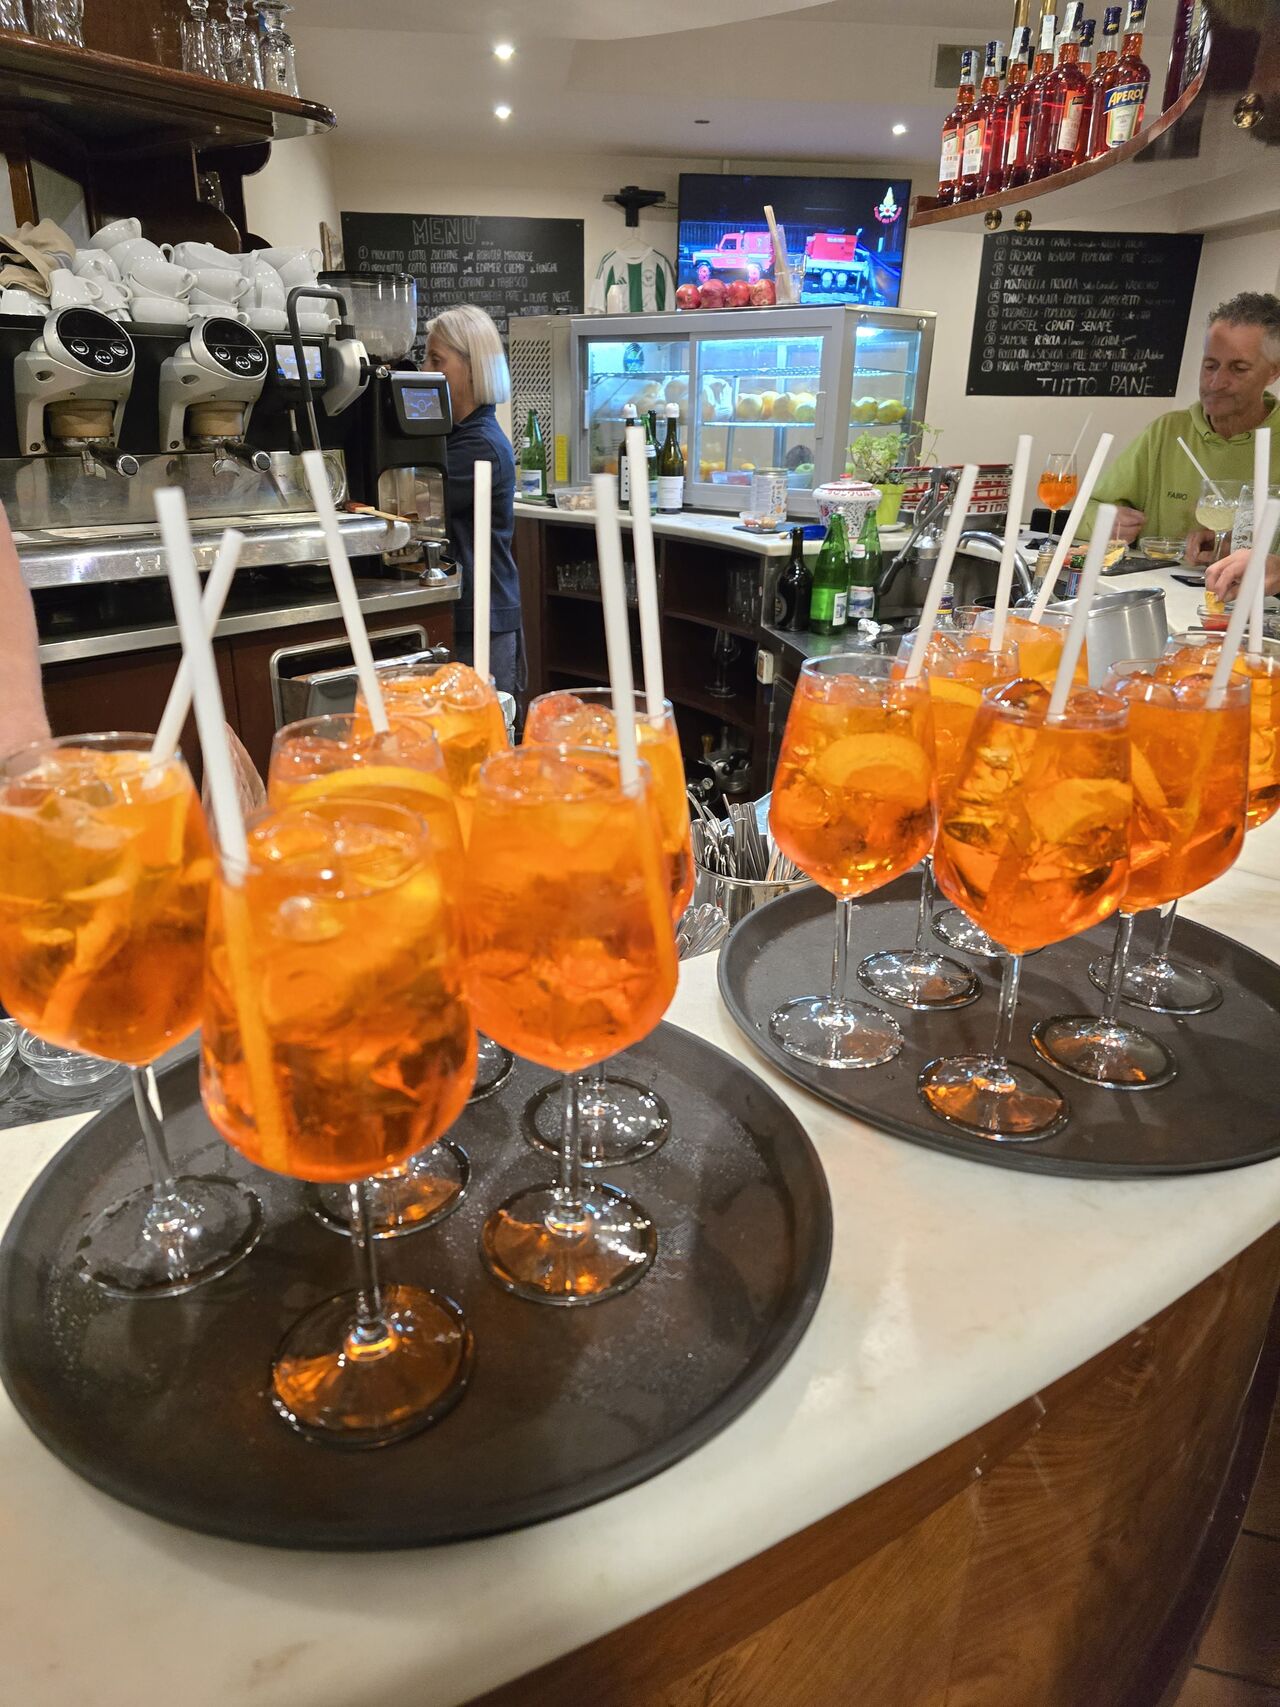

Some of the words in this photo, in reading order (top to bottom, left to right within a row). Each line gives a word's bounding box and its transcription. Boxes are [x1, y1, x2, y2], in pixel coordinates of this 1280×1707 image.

[1107, 88, 1145, 108] APEROL
[1008, 263, 1036, 277] SALAME
[1001, 319, 1038, 331] WURSTEL
[1045, 319, 1075, 331] CRAUTI
[1079, 319, 1114, 333] SENAPE
[1036, 376, 1097, 396] TUTTO
[1109, 375, 1155, 396] PANE
[1166, 490, 1188, 501] FABIO
